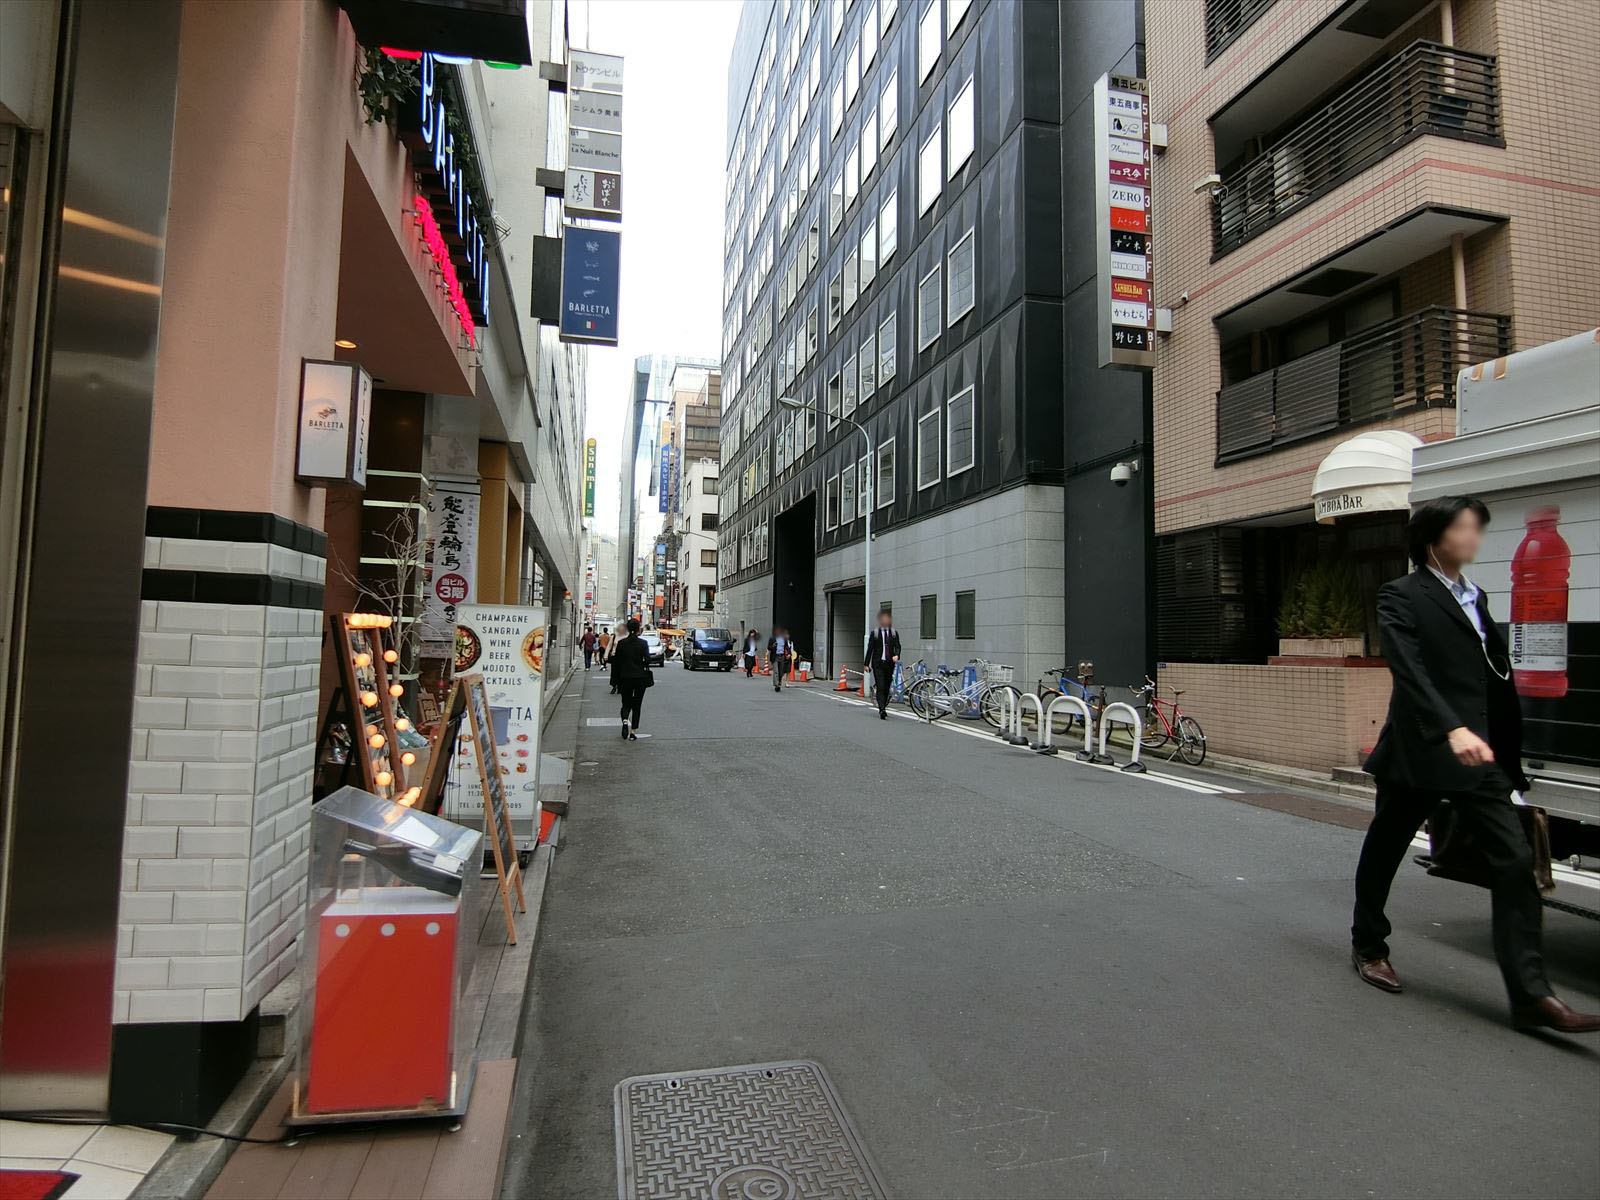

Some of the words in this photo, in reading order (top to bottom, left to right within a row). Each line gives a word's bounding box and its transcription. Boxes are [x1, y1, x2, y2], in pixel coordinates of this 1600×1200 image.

[575, 64, 621, 79] トウケンビル
[1111, 76, 1146, 92] 東五ビル
[1109, 96, 1140, 111] 東五商事
[1111, 189, 1141, 203] ZERO
[568, 302, 610, 315] BARLETTA
[1113, 307, 1145, 321] かわむら
[1115, 330, 1143, 344] 野じま
[308, 419, 344, 430] BARLETTA
[1342, 495, 1363, 510] BAR
[437, 495, 465, 571] 能登輪島
[441, 577, 465, 586] 当ビル
[439, 587, 465, 599] 3階
[475, 613, 528, 624] CHAMPAGNE
[482, 626, 521, 636] SANGRIA
[490, 639, 512, 648] WINE
[1512, 623, 1523, 664] vitamin
[489, 651, 510, 660] BEER
[482, 663, 516, 673] MOJOTO
[483, 676, 522, 686] CKTAILS
